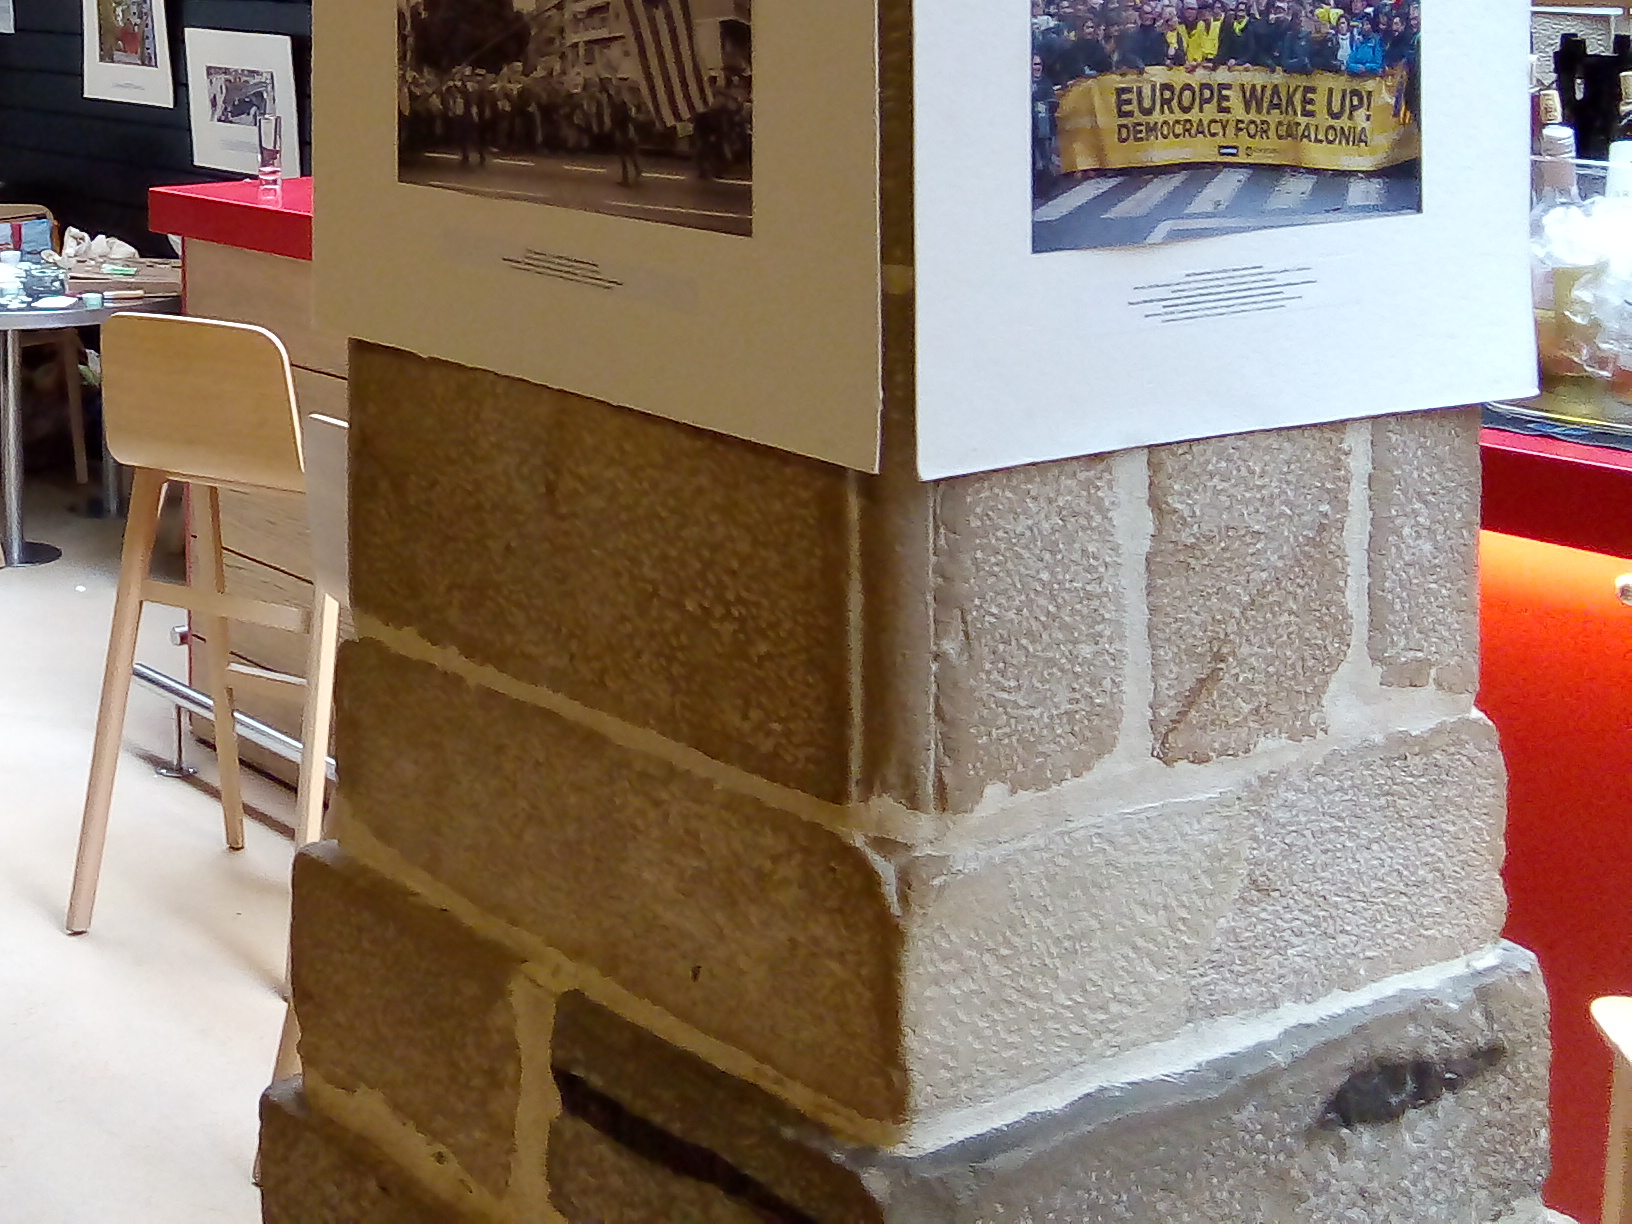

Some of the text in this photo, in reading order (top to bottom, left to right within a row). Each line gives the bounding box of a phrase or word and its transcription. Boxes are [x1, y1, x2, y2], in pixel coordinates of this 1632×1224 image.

[1115, 82, 1373, 121] EUROPE WAKE UP!
[1116, 118, 1370, 147] DEMOCRACY FOR CATALONIA
